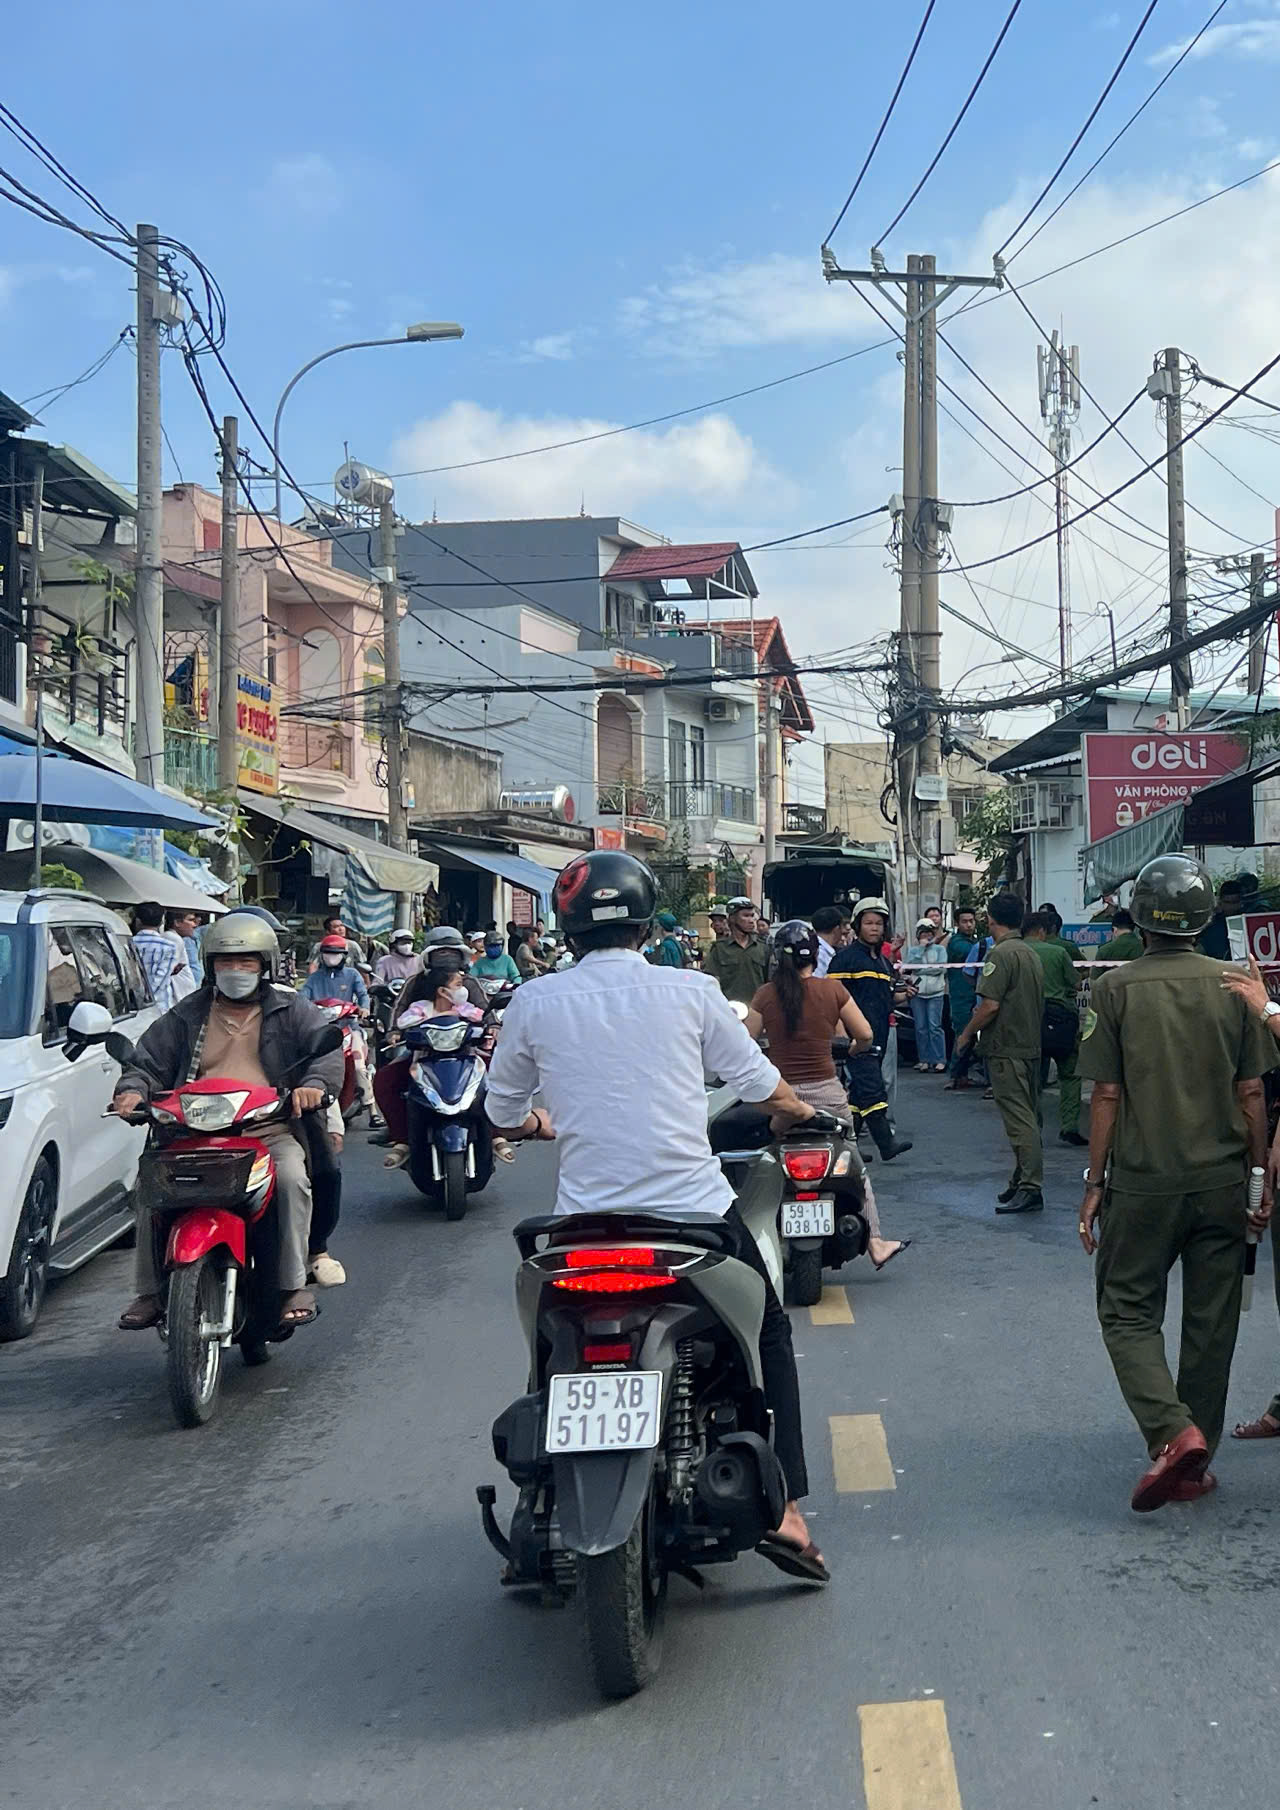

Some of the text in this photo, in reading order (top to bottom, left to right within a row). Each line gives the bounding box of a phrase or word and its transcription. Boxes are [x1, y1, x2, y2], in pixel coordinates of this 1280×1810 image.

[1130, 740, 1207, 770] deli
[1114, 784, 1141, 798] VĂN
[1143, 783, 1189, 797] PHÒNG
[789, 1204, 825, 1219] 59-T1
[785, 1219, 831, 1235] 038.16
[567, 1377, 644, 1411] 59-XB
[557, 1411, 650, 1446] 511.97
